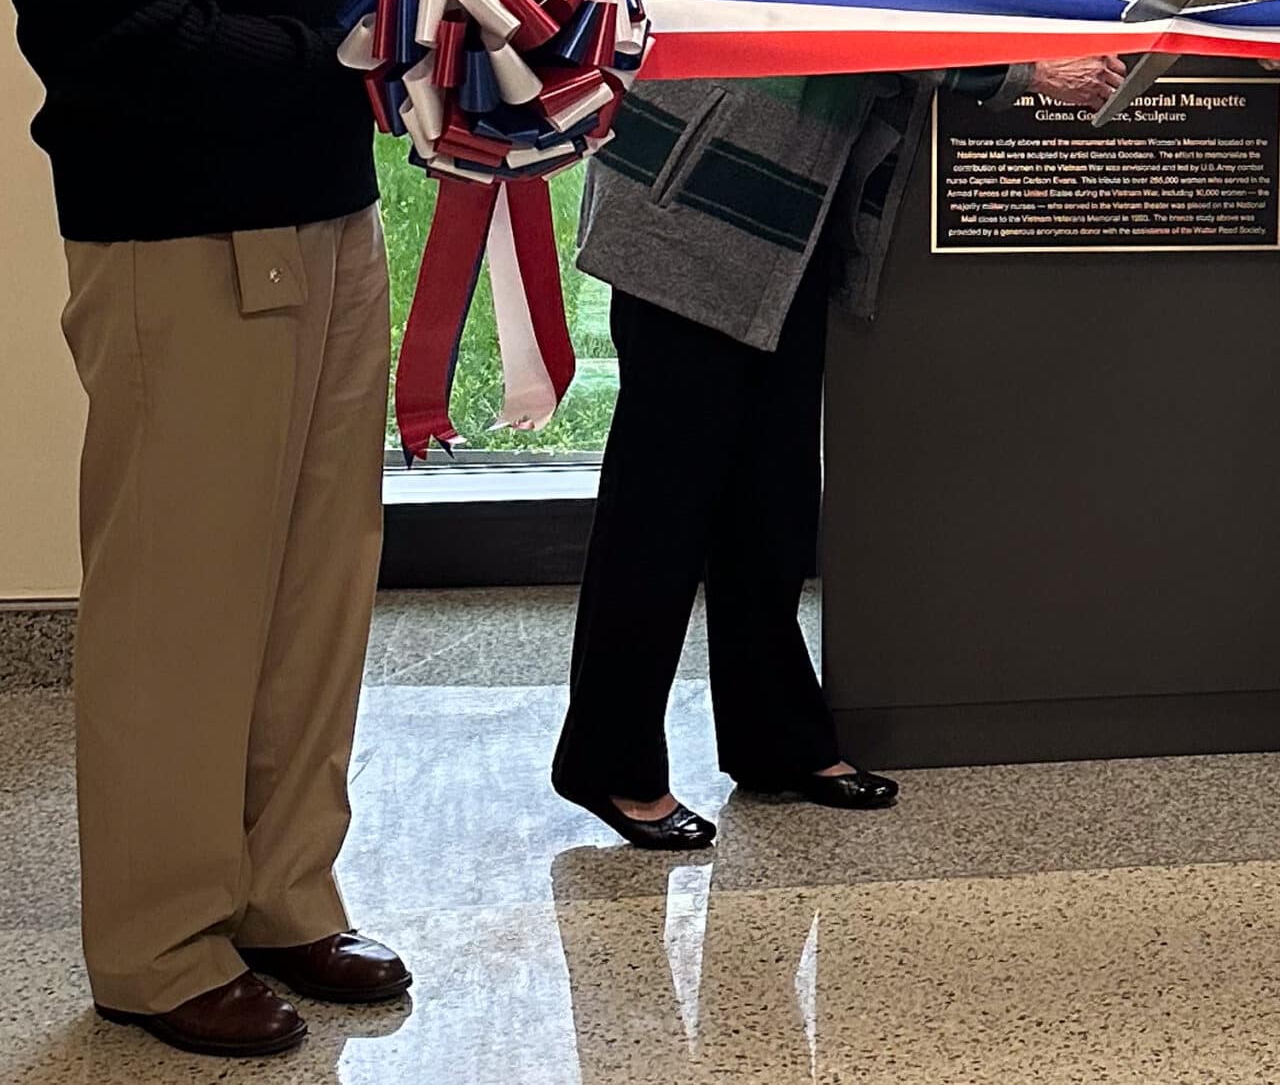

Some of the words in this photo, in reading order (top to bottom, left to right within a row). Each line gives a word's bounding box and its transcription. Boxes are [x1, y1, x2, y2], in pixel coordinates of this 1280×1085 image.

[1180, 93, 1247, 110] Maquette
[1035, 109, 1075, 121] Glenna
[1134, 110, 1188, 123] Sculpture
